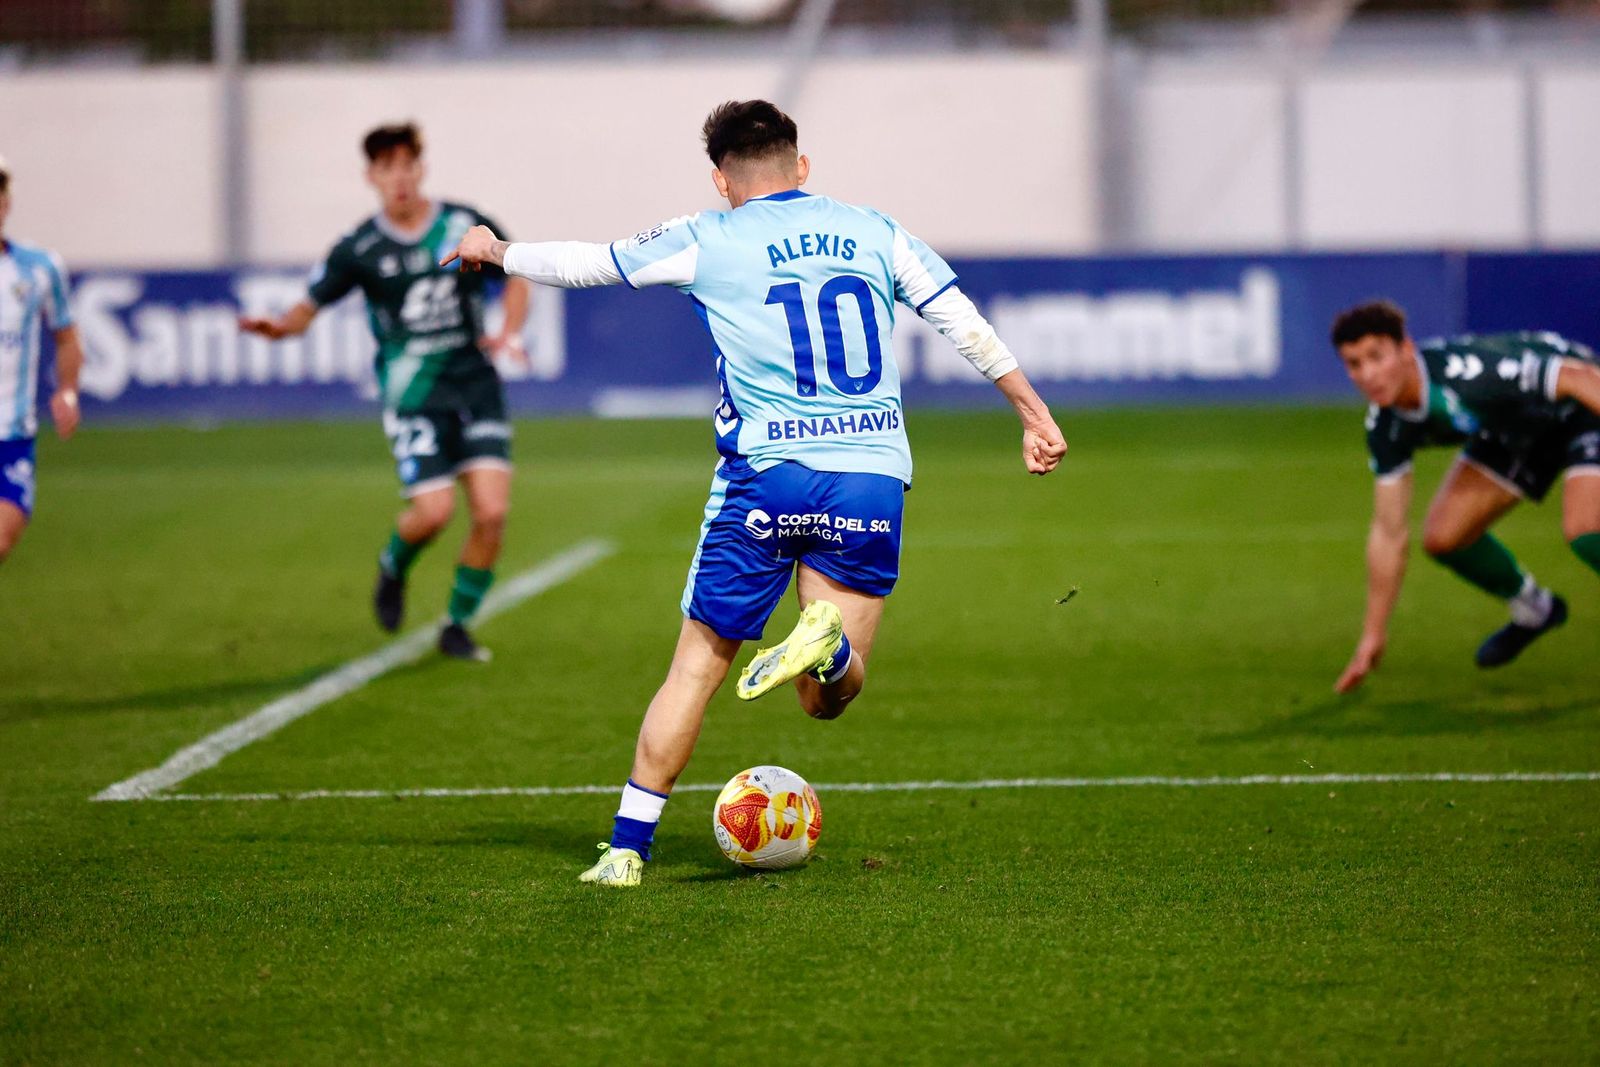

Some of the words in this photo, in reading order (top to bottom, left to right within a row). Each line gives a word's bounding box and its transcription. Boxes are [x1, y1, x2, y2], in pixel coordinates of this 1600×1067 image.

[766, 233, 857, 269] ALEXIS
[763, 274, 883, 397] 10
[767, 409, 899, 441] BENAHAVIS
[777, 513, 831, 526] COSTA
[834, 516, 867, 532] DEL
[869, 519, 891, 533] SOL
[778, 525, 843, 544] MÁLAGA
